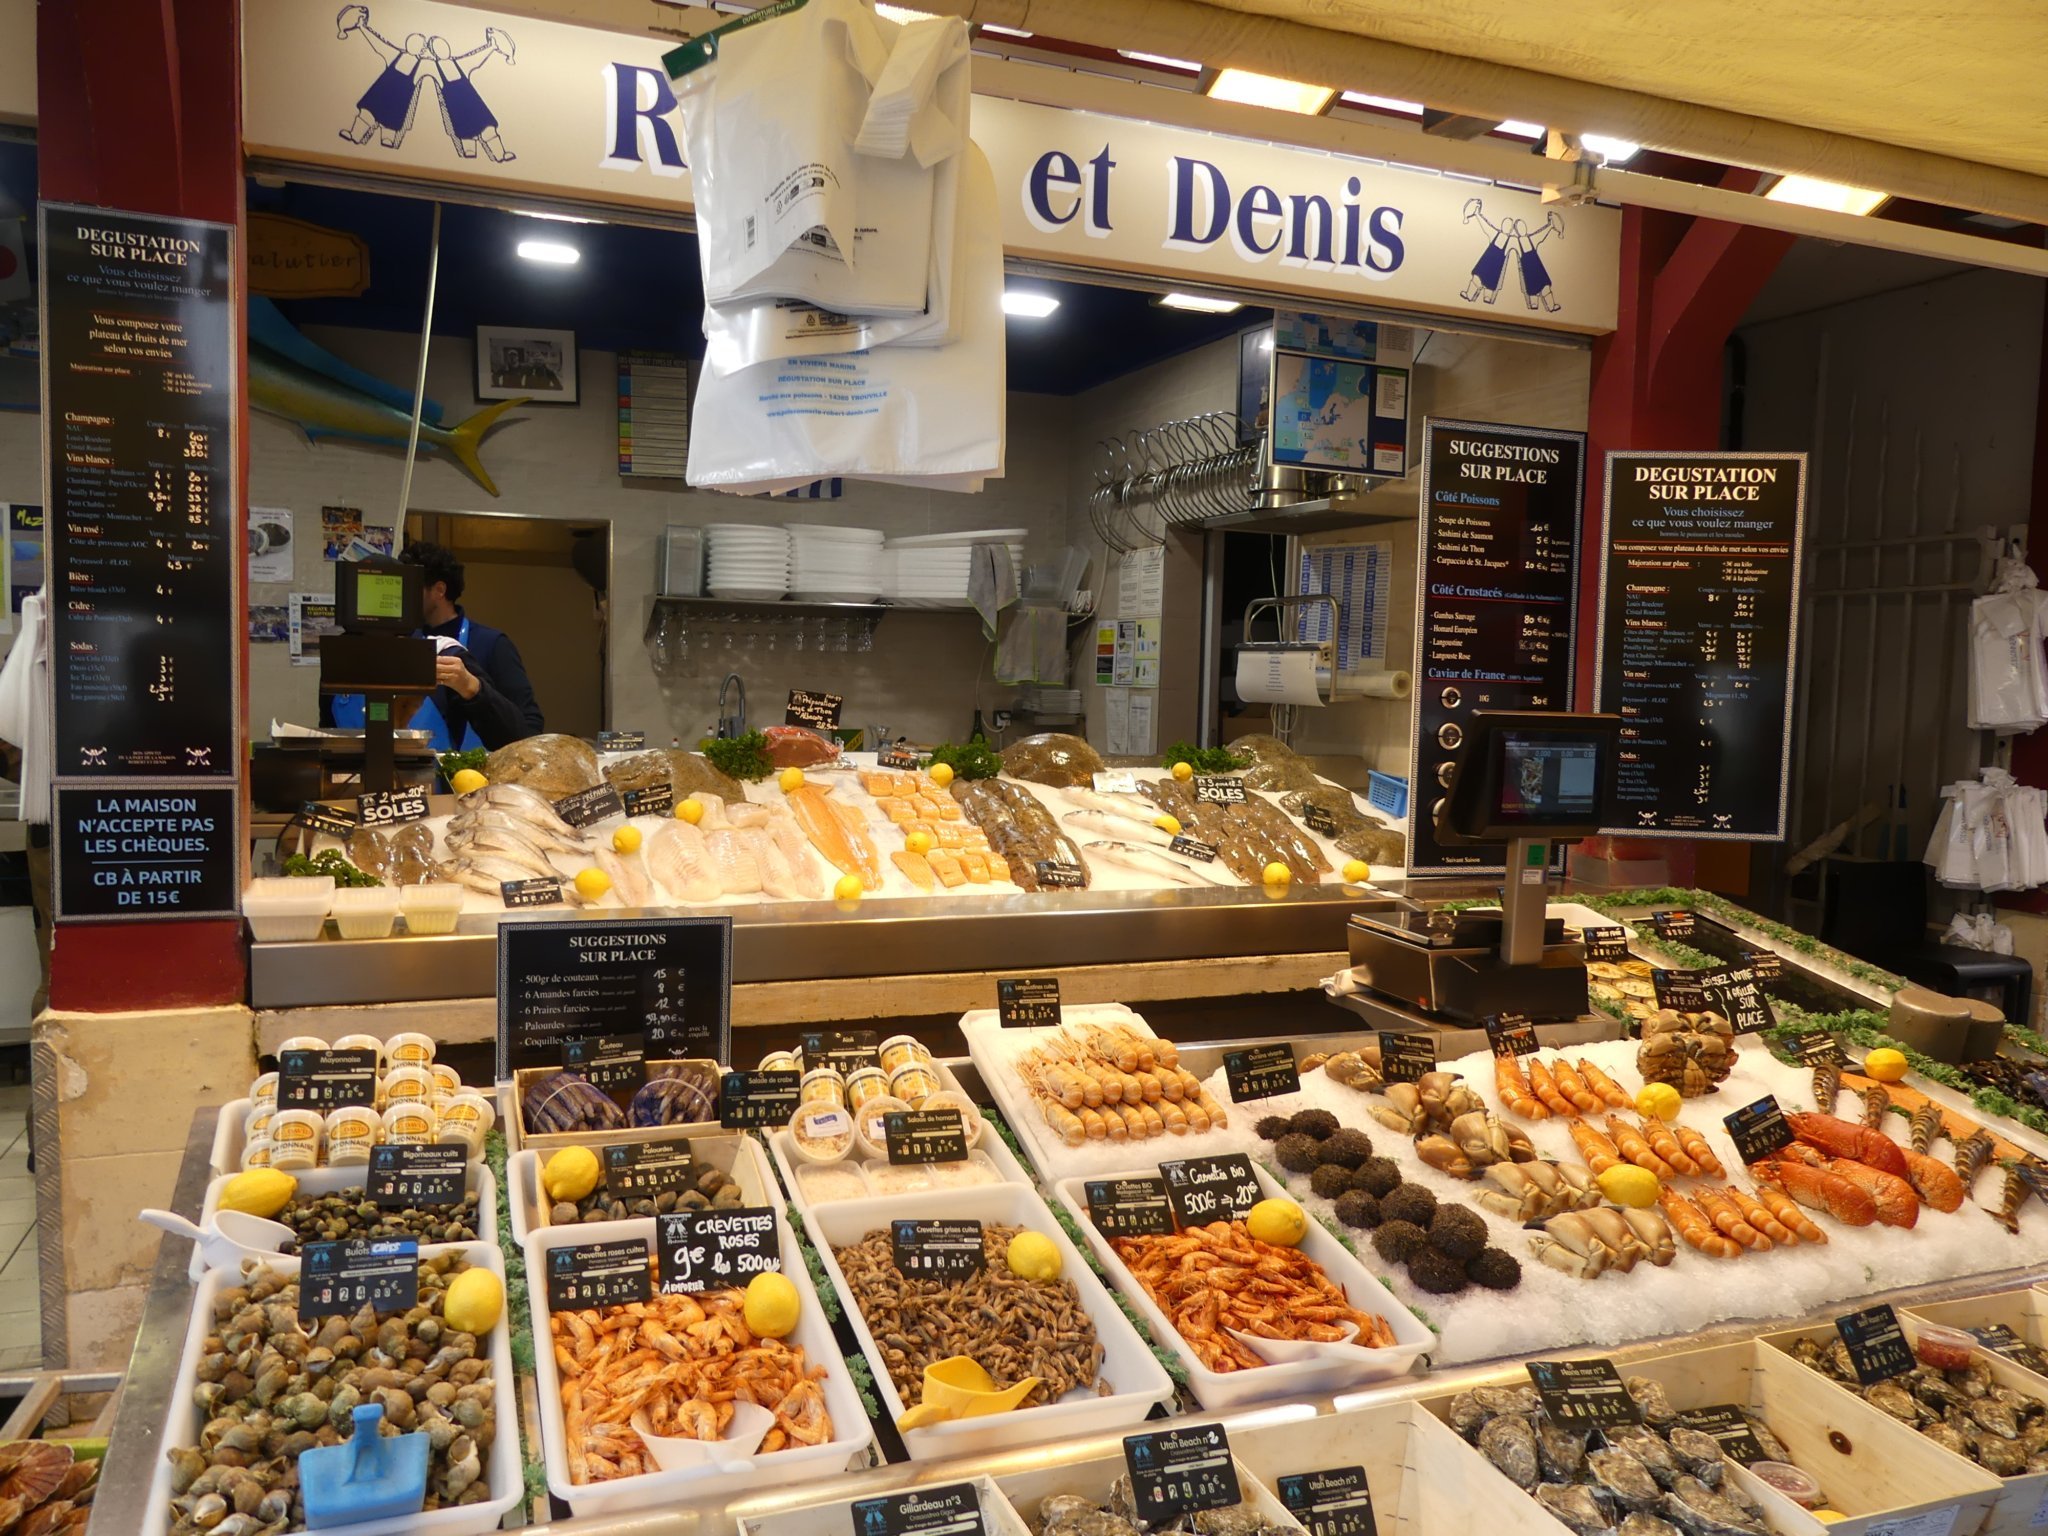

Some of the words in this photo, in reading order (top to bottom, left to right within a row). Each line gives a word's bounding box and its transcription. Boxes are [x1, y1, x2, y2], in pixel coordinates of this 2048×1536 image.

[1029, 142, 1117, 231] et
[1169, 155, 1405, 273] Denis
[77, 226, 201, 253] DEGUSTATION
[90, 243, 127, 259] SUR
[130, 248, 188, 266] PLACE
[98, 264, 127, 276] Vous
[128, 268, 182, 283] choisissez
[67, 274, 79, 282] ce
[82, 276, 102, 286] que
[105, 278, 131, 288] vous
[134, 281, 169, 292] voulez
[172, 286, 212, 300] manger
[93, 314, 115, 326] Vous
[117, 319, 160, 332] composez
[161, 322, 183, 333] votre
[89, 329, 121, 341] plateau
[122, 332, 133, 341] de
[135, 333, 157, 345] fruits
[159, 335, 169, 345] de
[171, 338, 188, 347] mer
[104, 344, 127, 354] selon
[129, 347, 144, 356] vos
[146, 349, 173, 358] envies
[65, 413, 110, 425] Champagne
[1449, 439, 1560, 464] SUGGESTIONS
[67, 453, 84, 463] Vins
[85, 455, 110, 465] blancs
[1460, 463, 1493, 480] SUR
[1495, 465, 1548, 485] PLACE
[1634, 466, 1777, 483] DEGUSTATION
[1435, 490, 1458, 503] Côté
[1460, 492, 1500, 506] Poissons
[1649, 484, 1689, 500] SUR
[1694, 485, 1760, 501] PLACE
[1663, 506, 1689, 517] Vous
[1691, 506, 1744, 518] choisissez
[1438, 516, 1456, 526] Soupe
[1465, 518, 1491, 527] Poissons
[1632, 519, 1645, 527] ce
[1647, 519, 1665, 529] que
[1669, 520, 1694, 528] vous
[1696, 518, 1731, 528] voulez
[1734, 520, 1774, 532] manger
[68, 524, 82, 534] Vin
[83, 525, 100, 535] rosé
[1438, 529, 1461, 538] Sashimi
[1462, 531, 1469, 539] de
[1470, 532, 1494, 540] Saumon
[1437, 543, 1460, 552] Sashimi
[1461, 544, 1469, 552] de
[1470, 545, 1485, 553] Thon
[69, 572, 90, 582] Bière
[1431, 583, 1454, 596] Côté
[1456, 585, 1502, 597] Crustacés
[1626, 584, 1666, 593] Champagne
[69, 601, 90, 610] Cidre
[1624, 618, 1642, 627] Vins
[1642, 618, 1664, 627] blancs
[70, 642, 93, 651] Sodas
[1428, 667, 1460, 679] Caviar
[1461, 669, 1473, 679] de
[1474, 669, 1505, 680] France
[378, 791, 388, 803] 2
[1198, 787, 1245, 800] SOLES
[96, 798, 121, 813] LA
[125, 798, 197, 813] MAISON
[363, 799, 426, 822] SOLES
[78, 818, 177, 833] N'ACCEPTE
[181, 818, 215, 832] PAS
[84, 839, 117, 853] LES
[121, 836, 210, 854] CHÈQUES.
[93, 871, 117, 886] CB
[121, 868, 135, 885] À
[138, 870, 202, 885] PARTIR
[117, 891, 142, 905] DE
[146, 890, 180, 904] 15€
[569, 933, 667, 948] SUGGESTIONS
[579, 951, 608, 963] SUR
[610, 949, 657, 962] PLACE
[525, 974, 549, 986] 500gr
[551, 973, 562, 983] de
[563, 973, 600, 983] couteaux
[524, 991, 531, 999] 6
[532, 989, 571, 999] Amandes
[572, 987, 600, 997] farcies
[524, 1006, 531, 1015] 6
[532, 1005, 562, 1015] Praires
[563, 1003, 590, 1013] farcies
[1739, 995, 1760, 1010] SUR
[525, 1020, 565, 1031] Palourdes
[1736, 1010, 1766, 1030] PLACE
[524, 1035, 564, 1048] Coquilles
[319, 1055, 361, 1064] Mayonnaise
[402, 1150, 442, 1159] Bigorneaux
[442, 1150, 459, 1158] cuits
[694, 1214, 773, 1234] CREVETTES
[943, 1226, 961, 1234] grises
[718, 1233, 760, 1250] ROSES
[345, 1247, 370, 1257] Bulots
[576, 1250, 607, 1260] Crevettes
[607, 1248, 626, 1258] roses
[626, 1246, 645, 1255] cuites
[1160, 1440, 1178, 1451] Utah
[1179, 1435, 1202, 1449] Beach
[1308, 1481, 1325, 1490] Utah
[1325, 1477, 1346, 1488] Beach
[899, 1499, 945, 1515] Gillardeau
[945, 1494, 962, 1507] n°3
